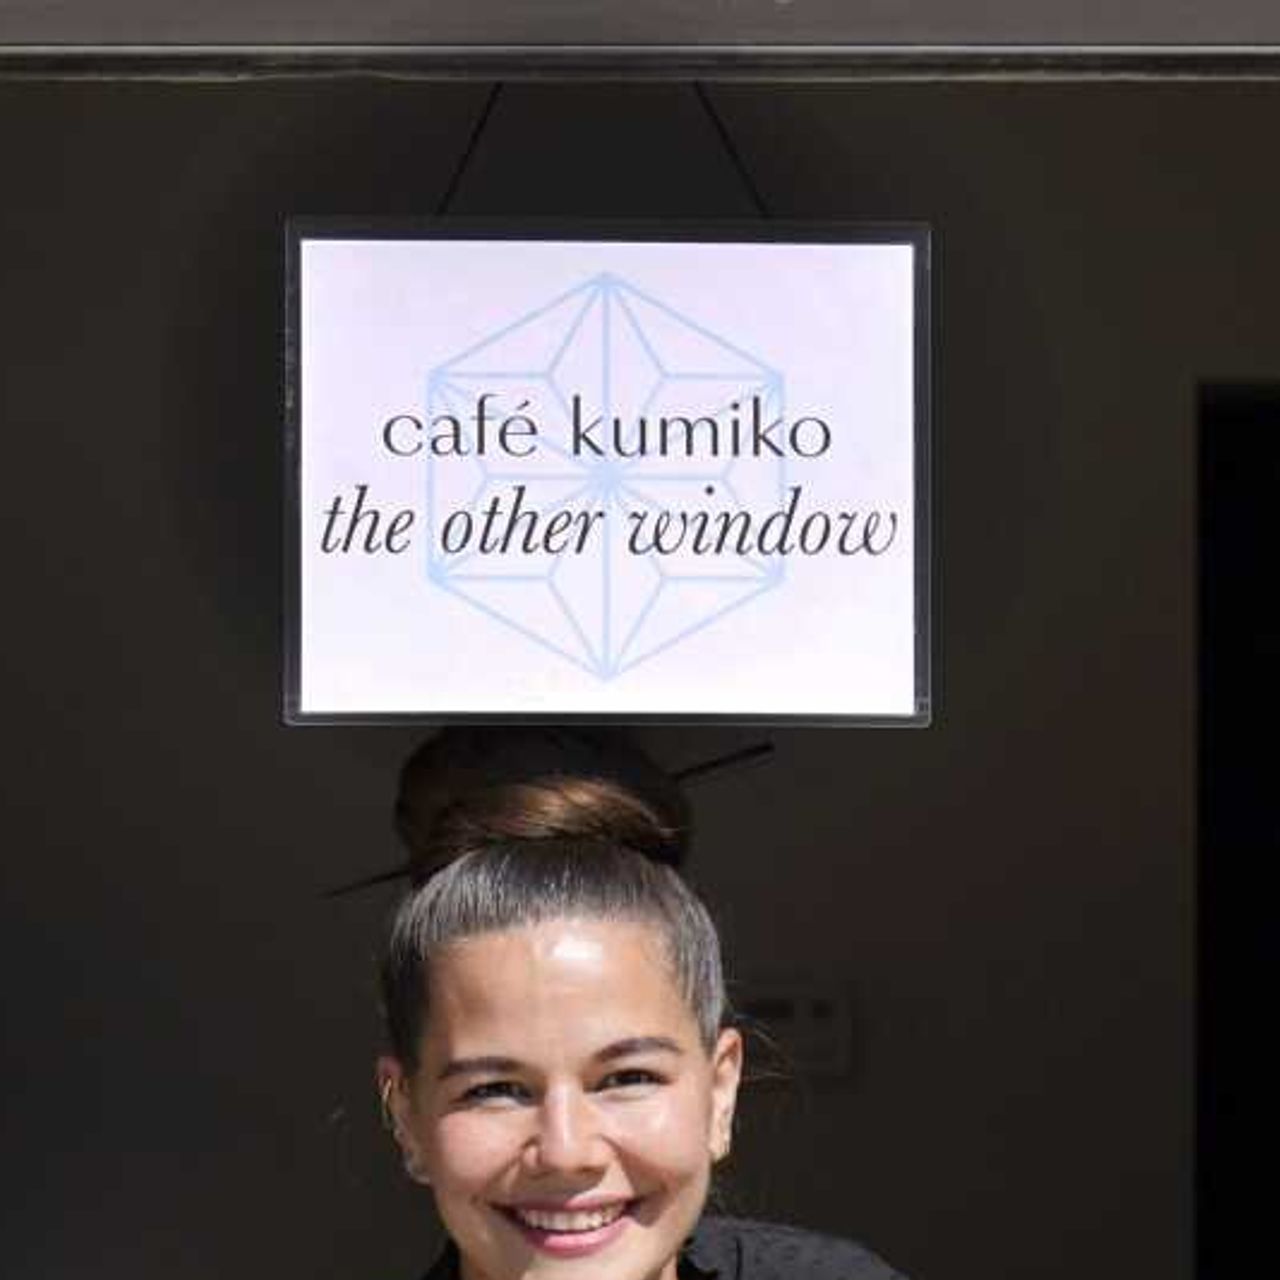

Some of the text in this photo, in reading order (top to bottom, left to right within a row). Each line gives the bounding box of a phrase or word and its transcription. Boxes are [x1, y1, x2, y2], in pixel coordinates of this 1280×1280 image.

[382, 394, 833, 458] café kumiko
[320, 485, 898, 556] the other window
